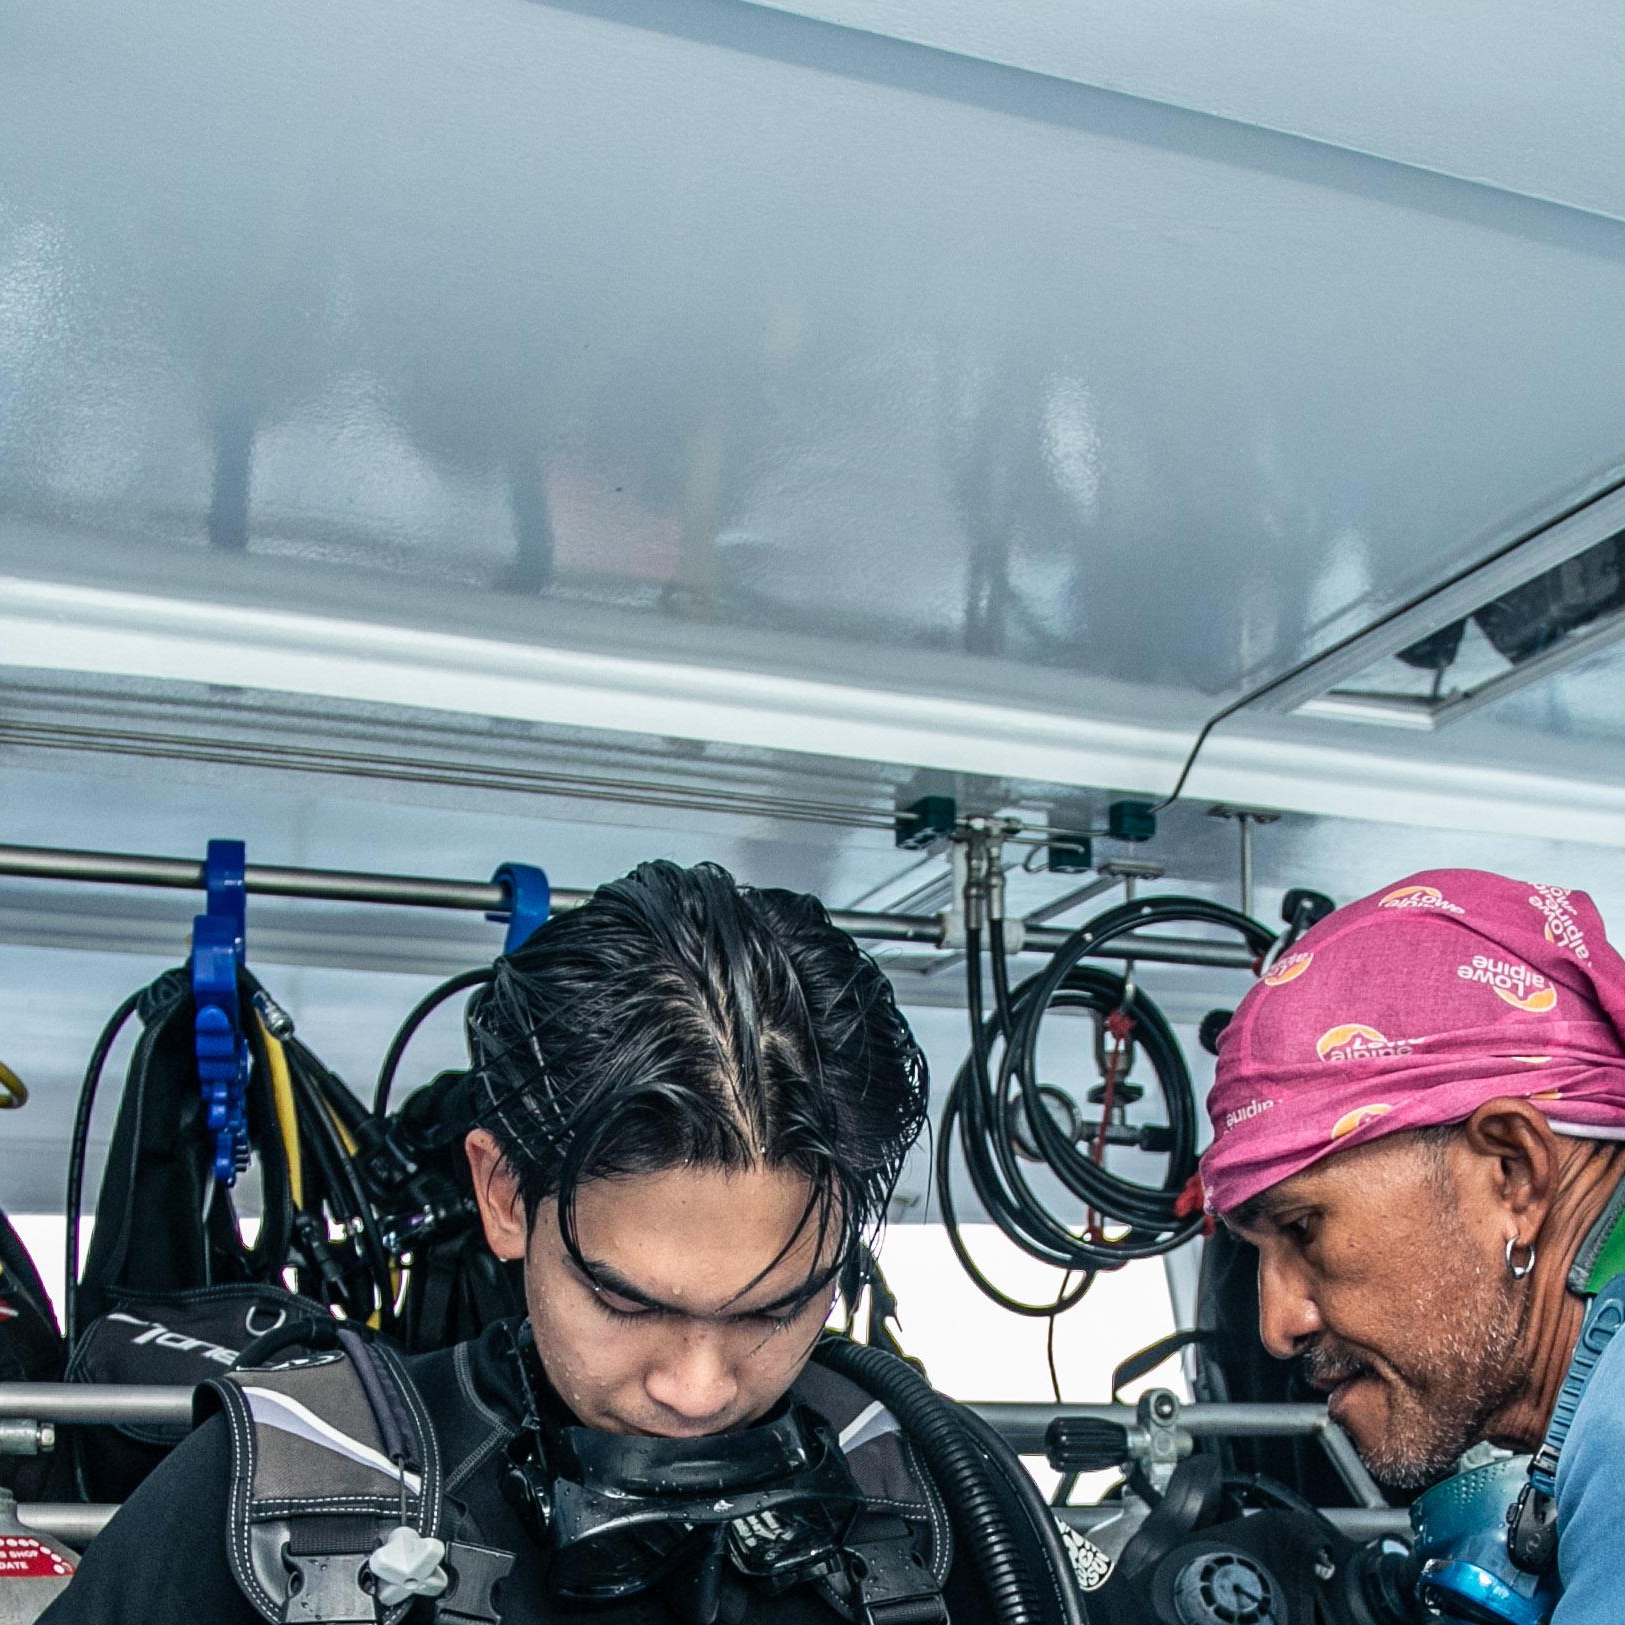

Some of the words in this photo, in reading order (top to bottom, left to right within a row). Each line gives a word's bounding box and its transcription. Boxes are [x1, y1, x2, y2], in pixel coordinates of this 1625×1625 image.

[1410, 891, 1466, 915] Lowe
[1528, 895, 1570, 948] Lowe
[1544, 898, 1590, 960] alpine
[1456, 964, 1524, 998] Lowe
[1472, 954, 1546, 989] alpine
[9, 1549, 39, 1558] SHOP
